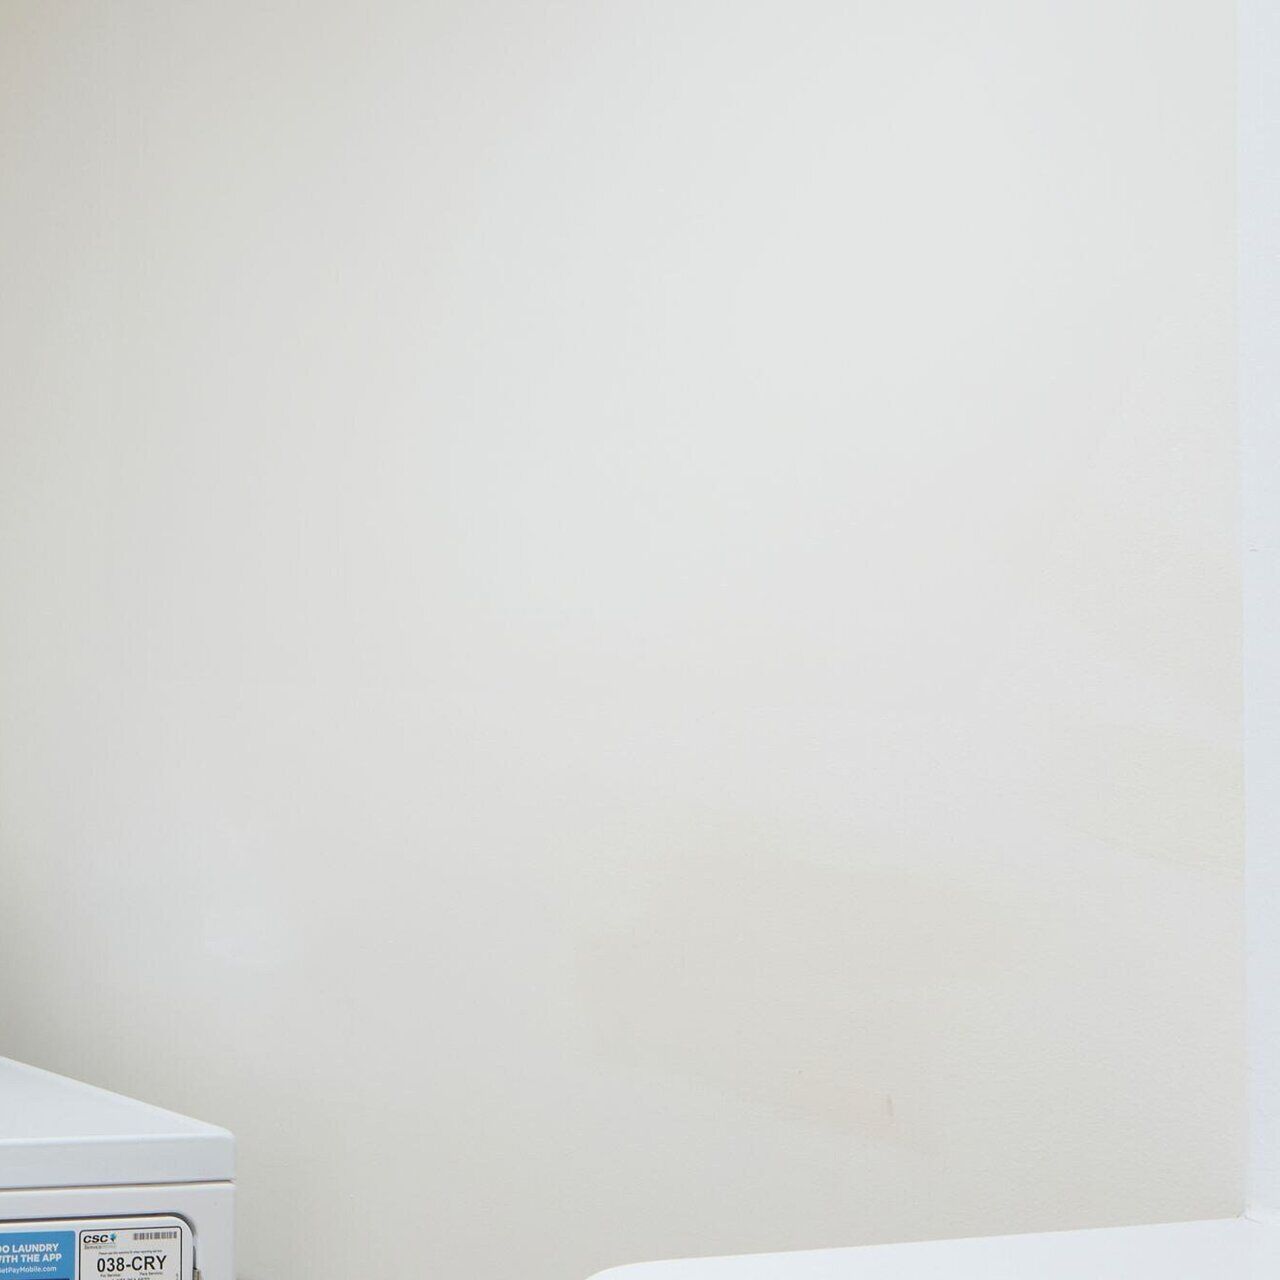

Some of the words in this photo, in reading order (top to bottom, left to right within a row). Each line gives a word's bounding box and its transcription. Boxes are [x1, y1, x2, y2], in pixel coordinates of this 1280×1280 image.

[83, 1234, 109, 1244] CSC
[12, 1243, 59, 1253] LAUNDRY
[20, 1254, 41, 1263] THE
[42, 1253, 62, 1262] APP
[97, 1255, 167, 1272] 038-CRY
